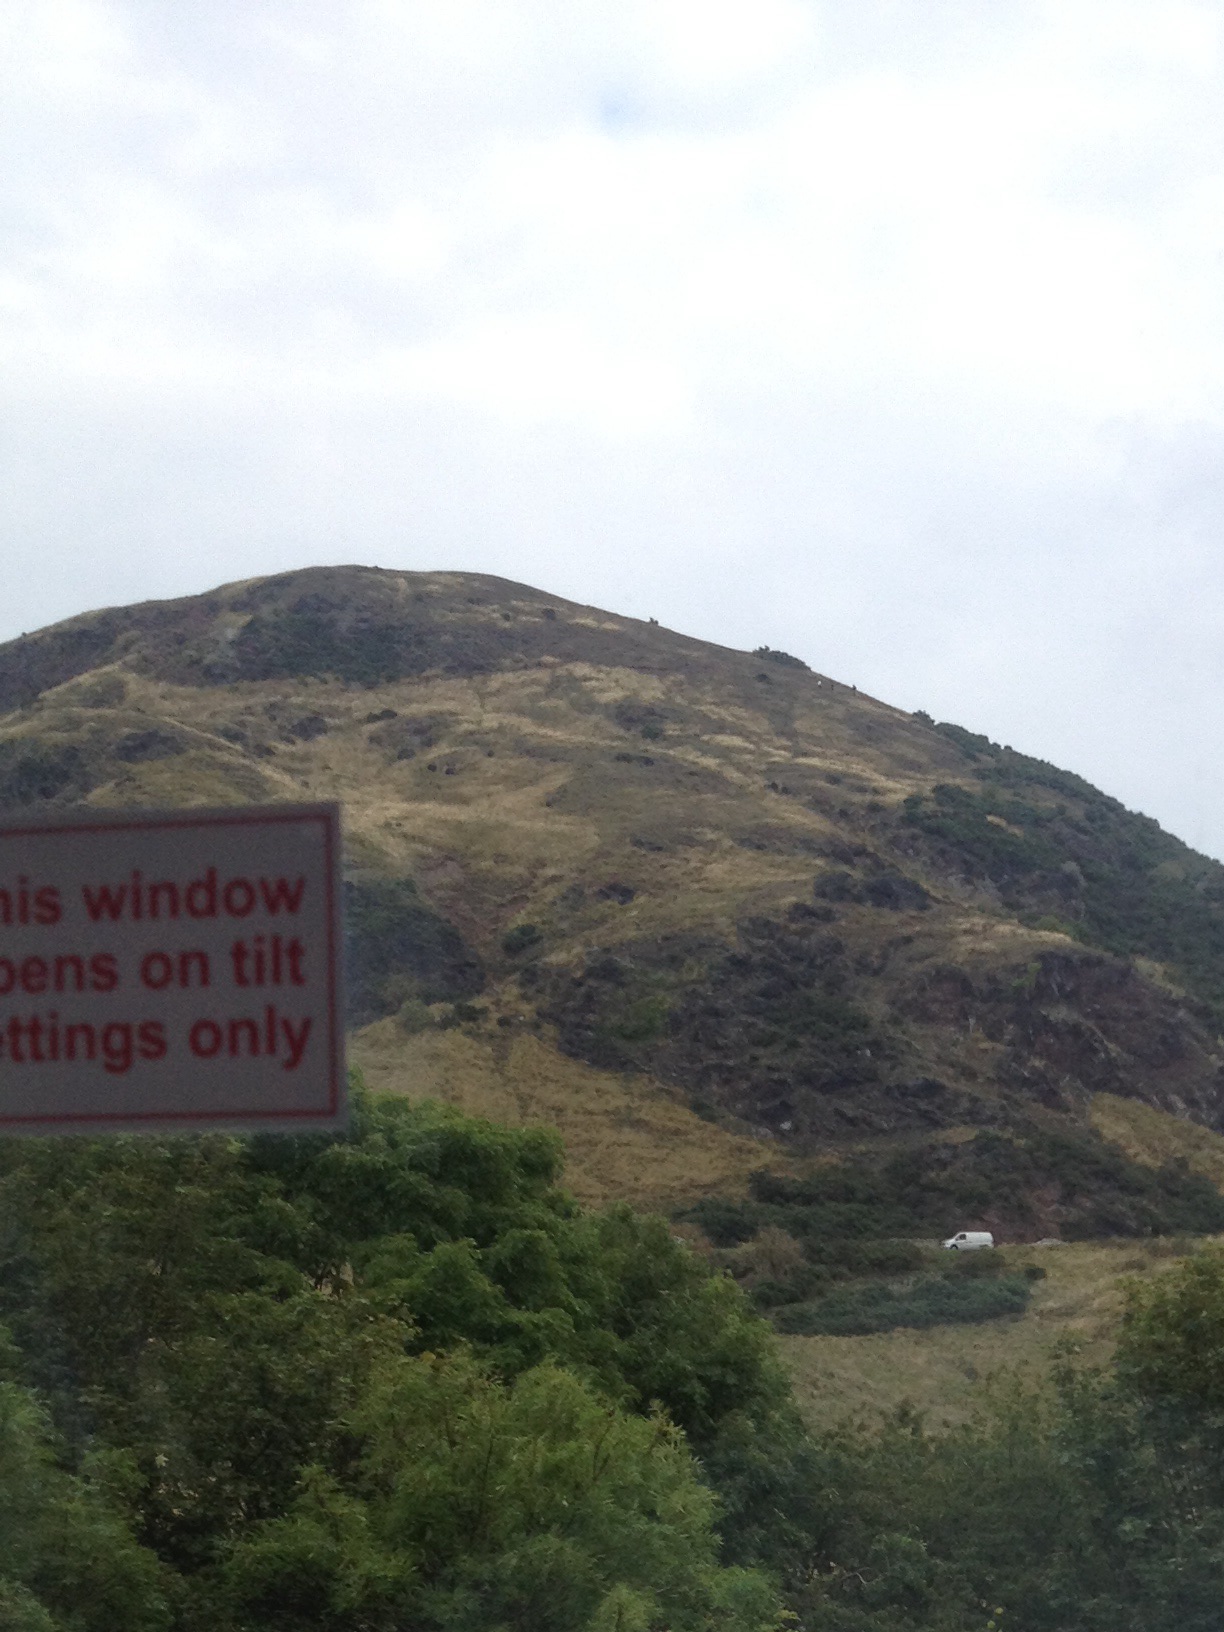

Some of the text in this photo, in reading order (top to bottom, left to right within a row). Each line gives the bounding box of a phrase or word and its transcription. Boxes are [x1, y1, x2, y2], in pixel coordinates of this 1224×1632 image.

[81, 866, 306, 922] window
[139, 950, 211, 991] on
[230, 934, 306, 988] tilt
[0, 1003, 314, 1076] ttings only
